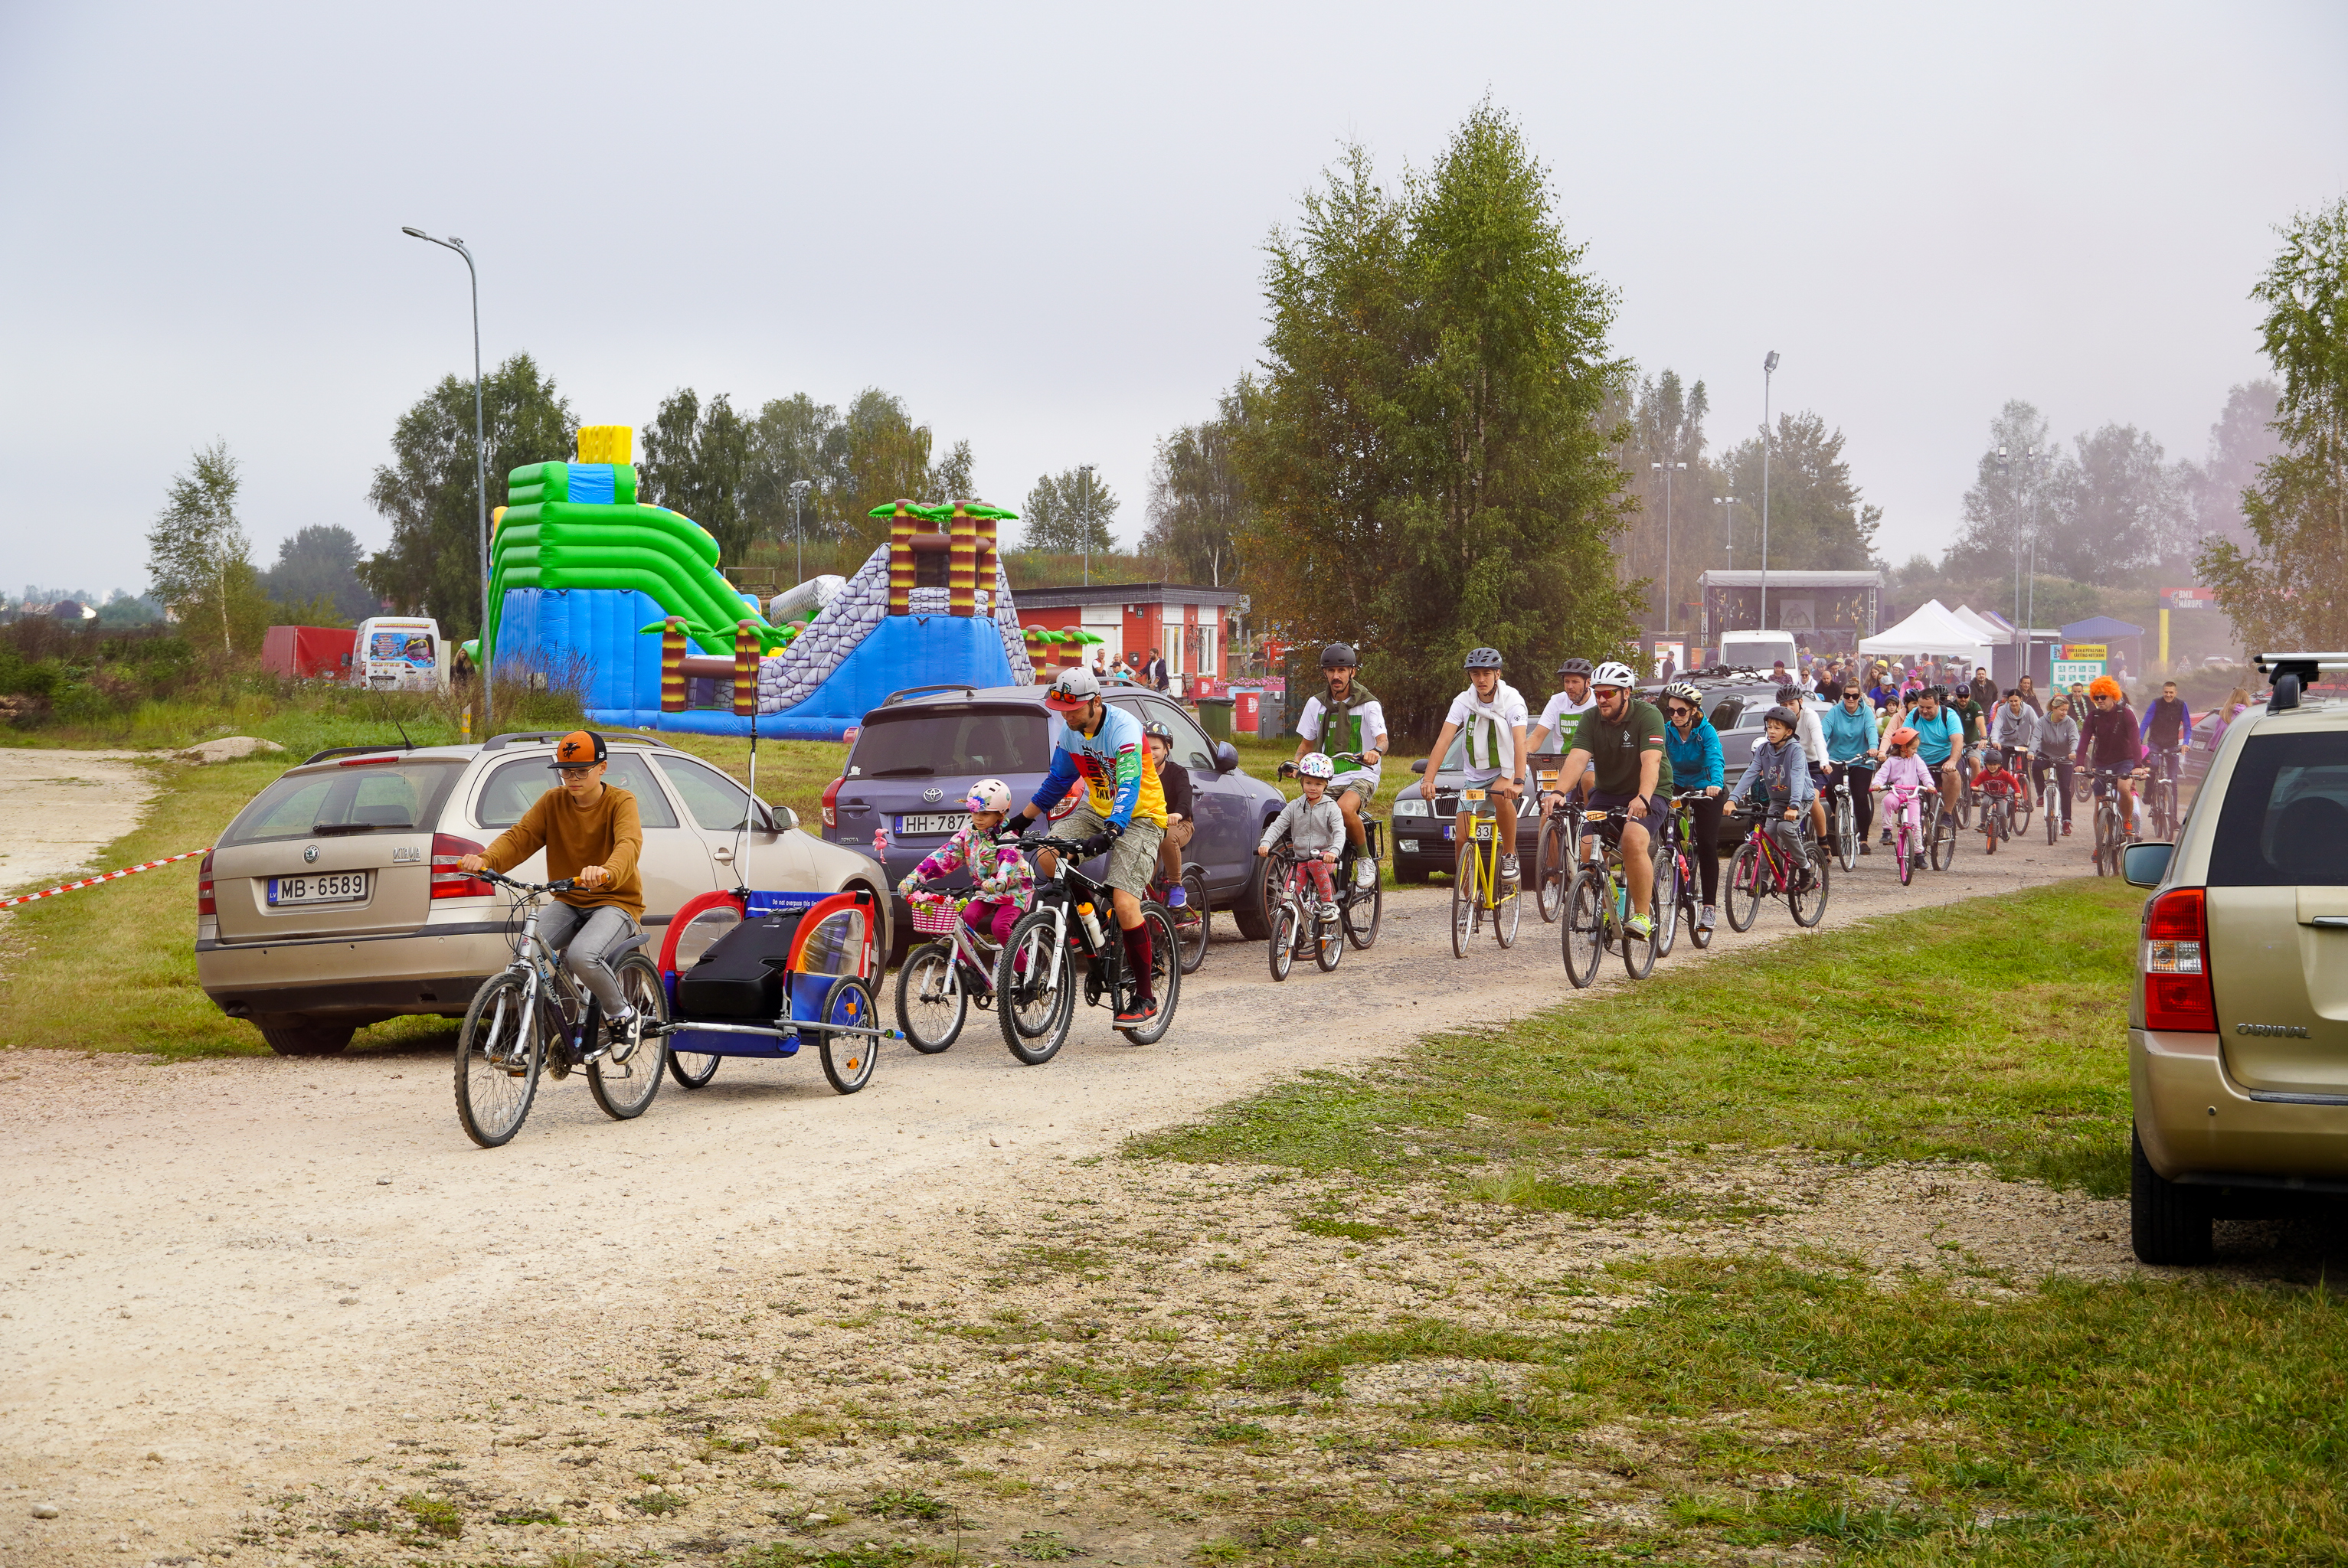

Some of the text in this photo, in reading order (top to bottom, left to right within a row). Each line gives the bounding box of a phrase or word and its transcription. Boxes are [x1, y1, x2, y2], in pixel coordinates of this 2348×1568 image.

[2178, 590, 2193, 599] BMX
[2178, 599, 2202, 608] MĀRUPE
[1095, 787, 1110, 801] BMX
[393, 847, 420, 858] OCTAVIA
[281, 875, 362, 899] MB-6589
[2236, 1023, 2311, 1039] CARNIVAL
